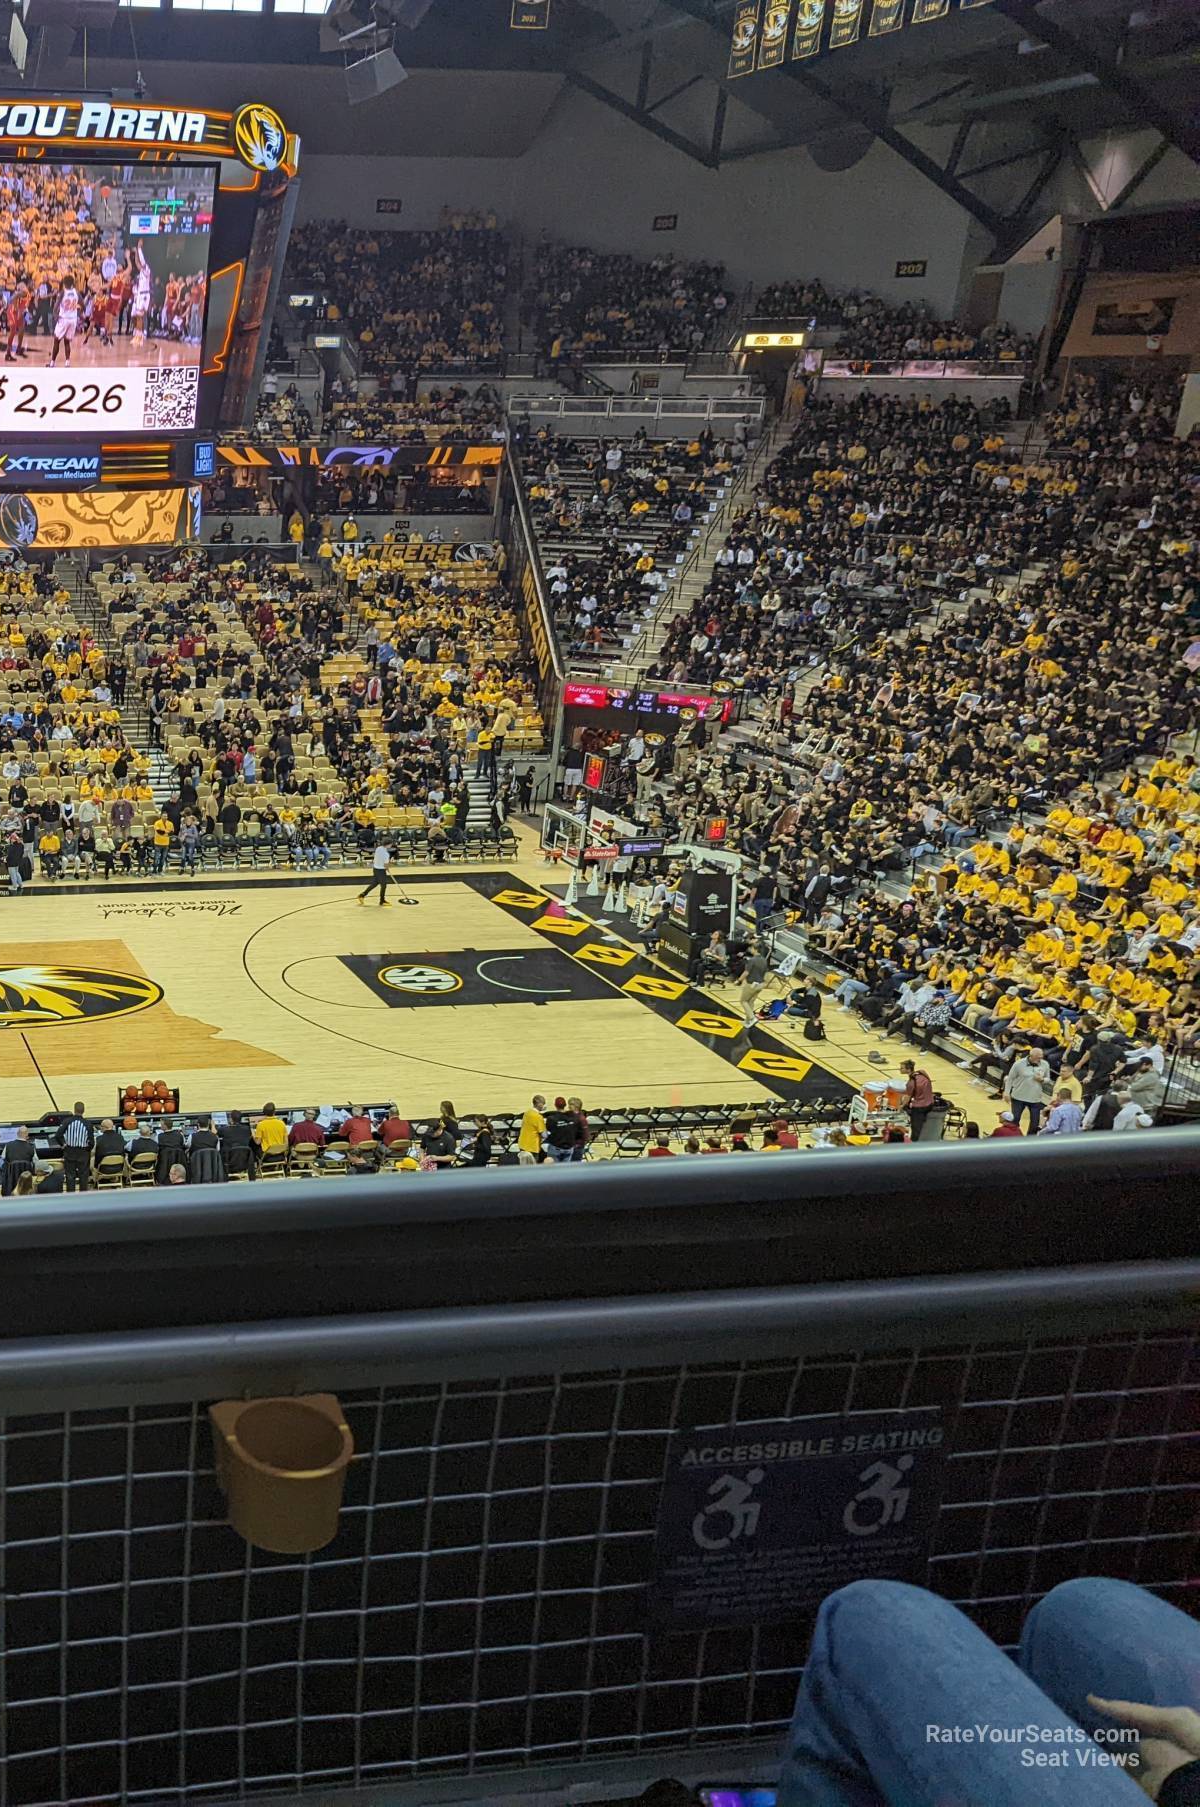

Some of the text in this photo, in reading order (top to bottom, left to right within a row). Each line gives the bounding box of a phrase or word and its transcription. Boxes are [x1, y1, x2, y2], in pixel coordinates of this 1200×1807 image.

[76, 102, 206, 143] ARENA
[13, 384, 126, 418] 2,226
[198, 446, 211, 459] BUD
[4, 456, 99, 471] XTREAM
[196, 459, 213, 473] LIGHT
[63, 471, 97, 479] Mediacom
[367, 544, 453, 561] TIGERS
[612, 700, 623, 708] 42
[667, 705, 679, 714] 32
[680, 1427, 944, 1467] ACCESSIBLE SEATING
